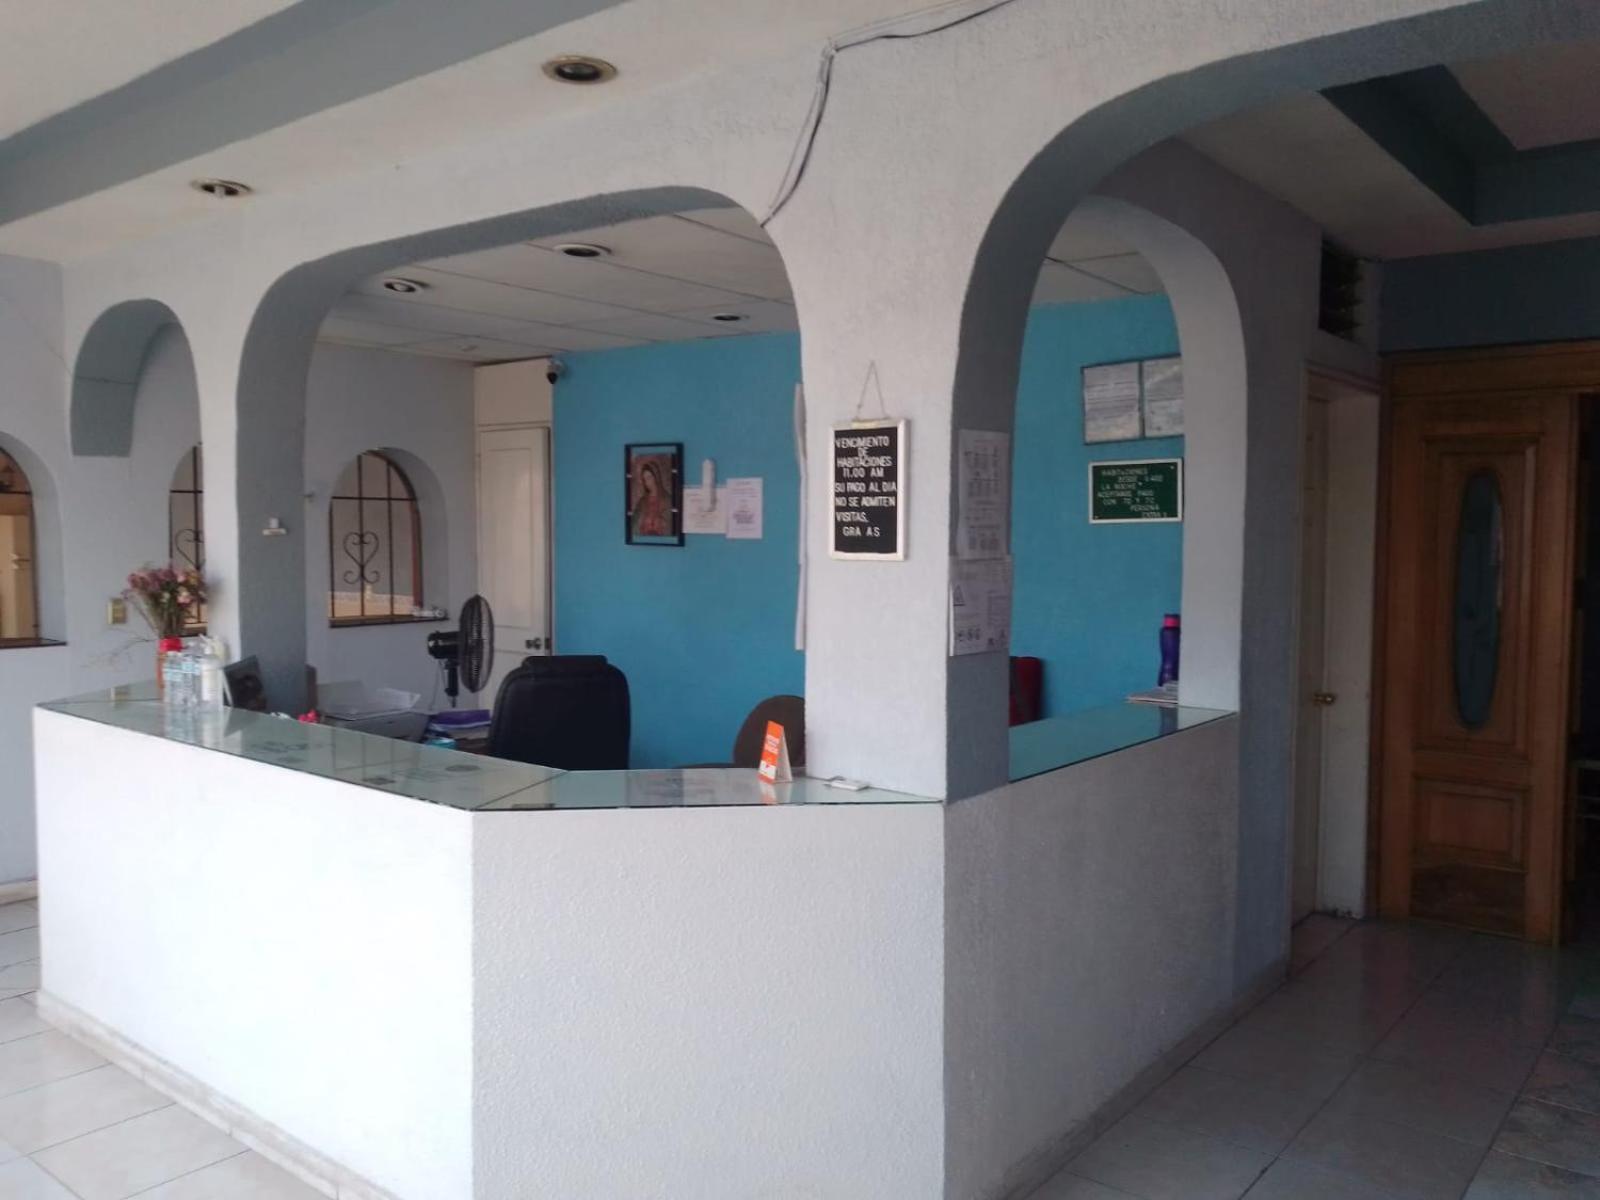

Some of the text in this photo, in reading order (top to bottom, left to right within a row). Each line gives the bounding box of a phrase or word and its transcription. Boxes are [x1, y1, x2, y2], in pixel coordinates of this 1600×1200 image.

[871, 467, 884, 477] AM
[835, 482, 845, 492] SU
[847, 482, 866, 492] PAGO
[869, 481, 880, 491] AL
[835, 496, 895, 507] NO SE ADMITEN
